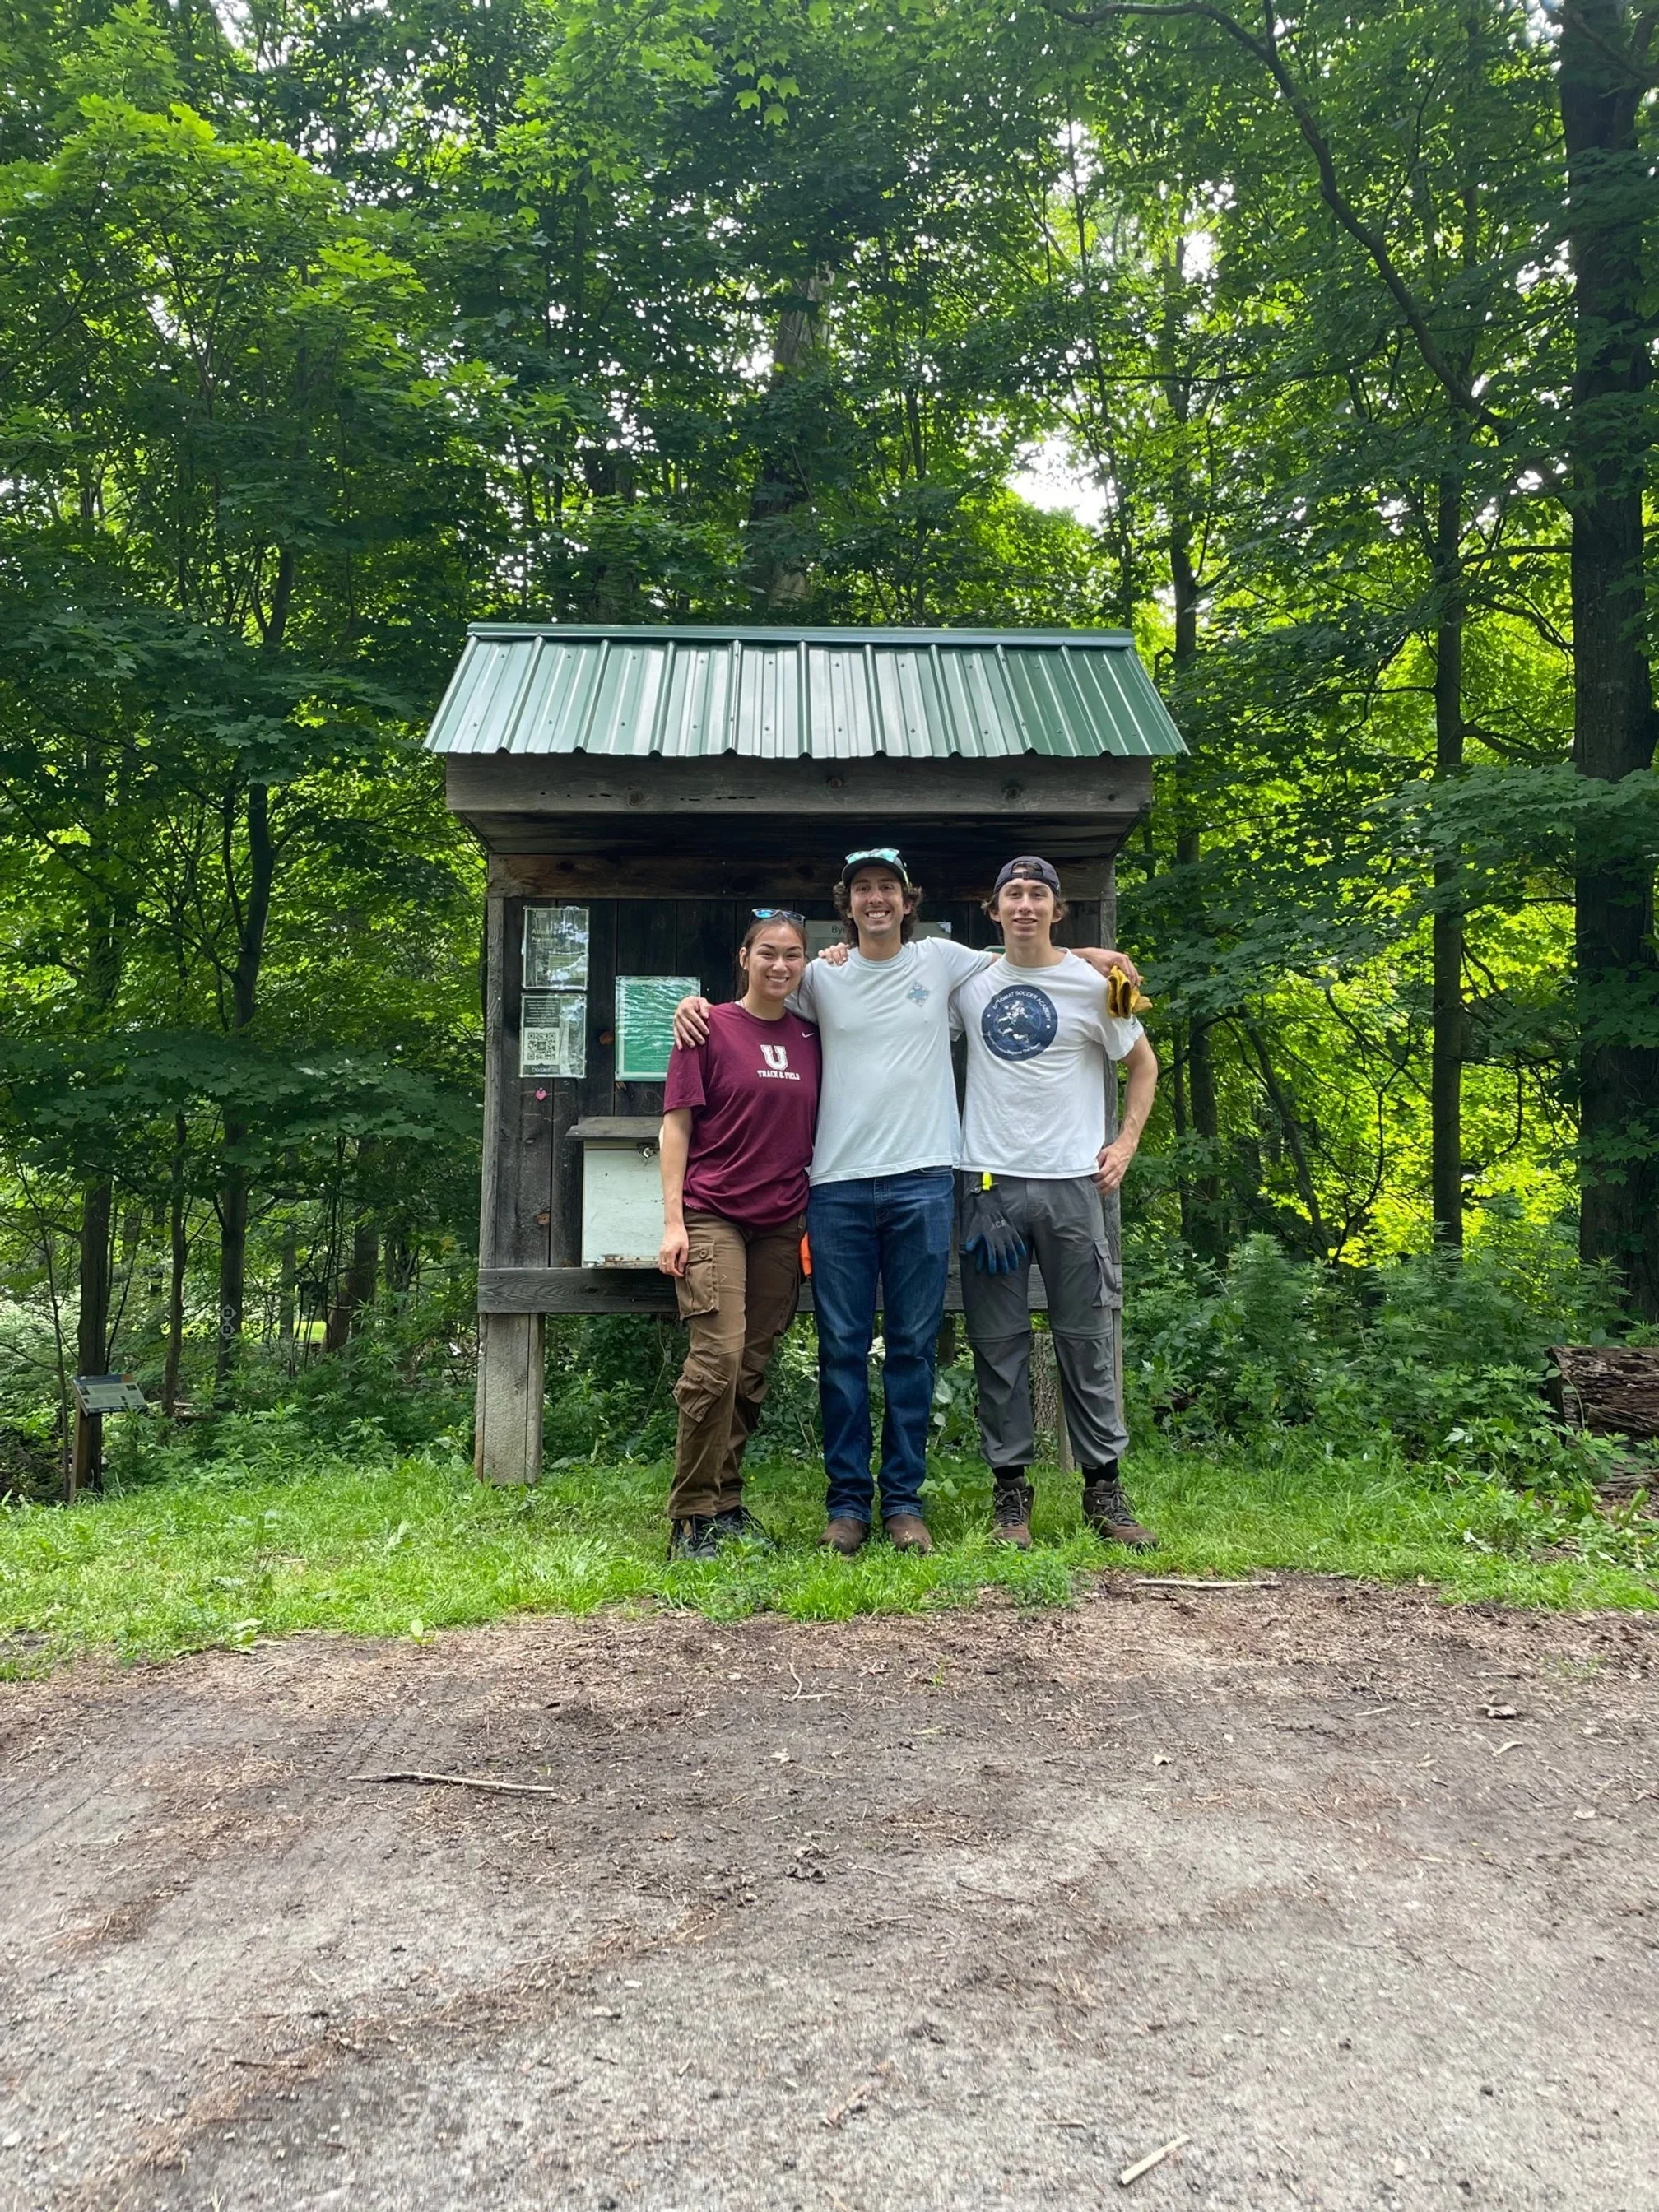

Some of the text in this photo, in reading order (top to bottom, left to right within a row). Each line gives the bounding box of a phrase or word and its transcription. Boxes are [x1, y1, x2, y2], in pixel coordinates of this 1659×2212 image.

[1015, 990, 1039, 1000] SOCCER
[1036, 997, 1052, 1022] ACADEMY
[760, 1044, 789, 1071] U
[756, 1069, 801, 1080] TRACK & FIELD
